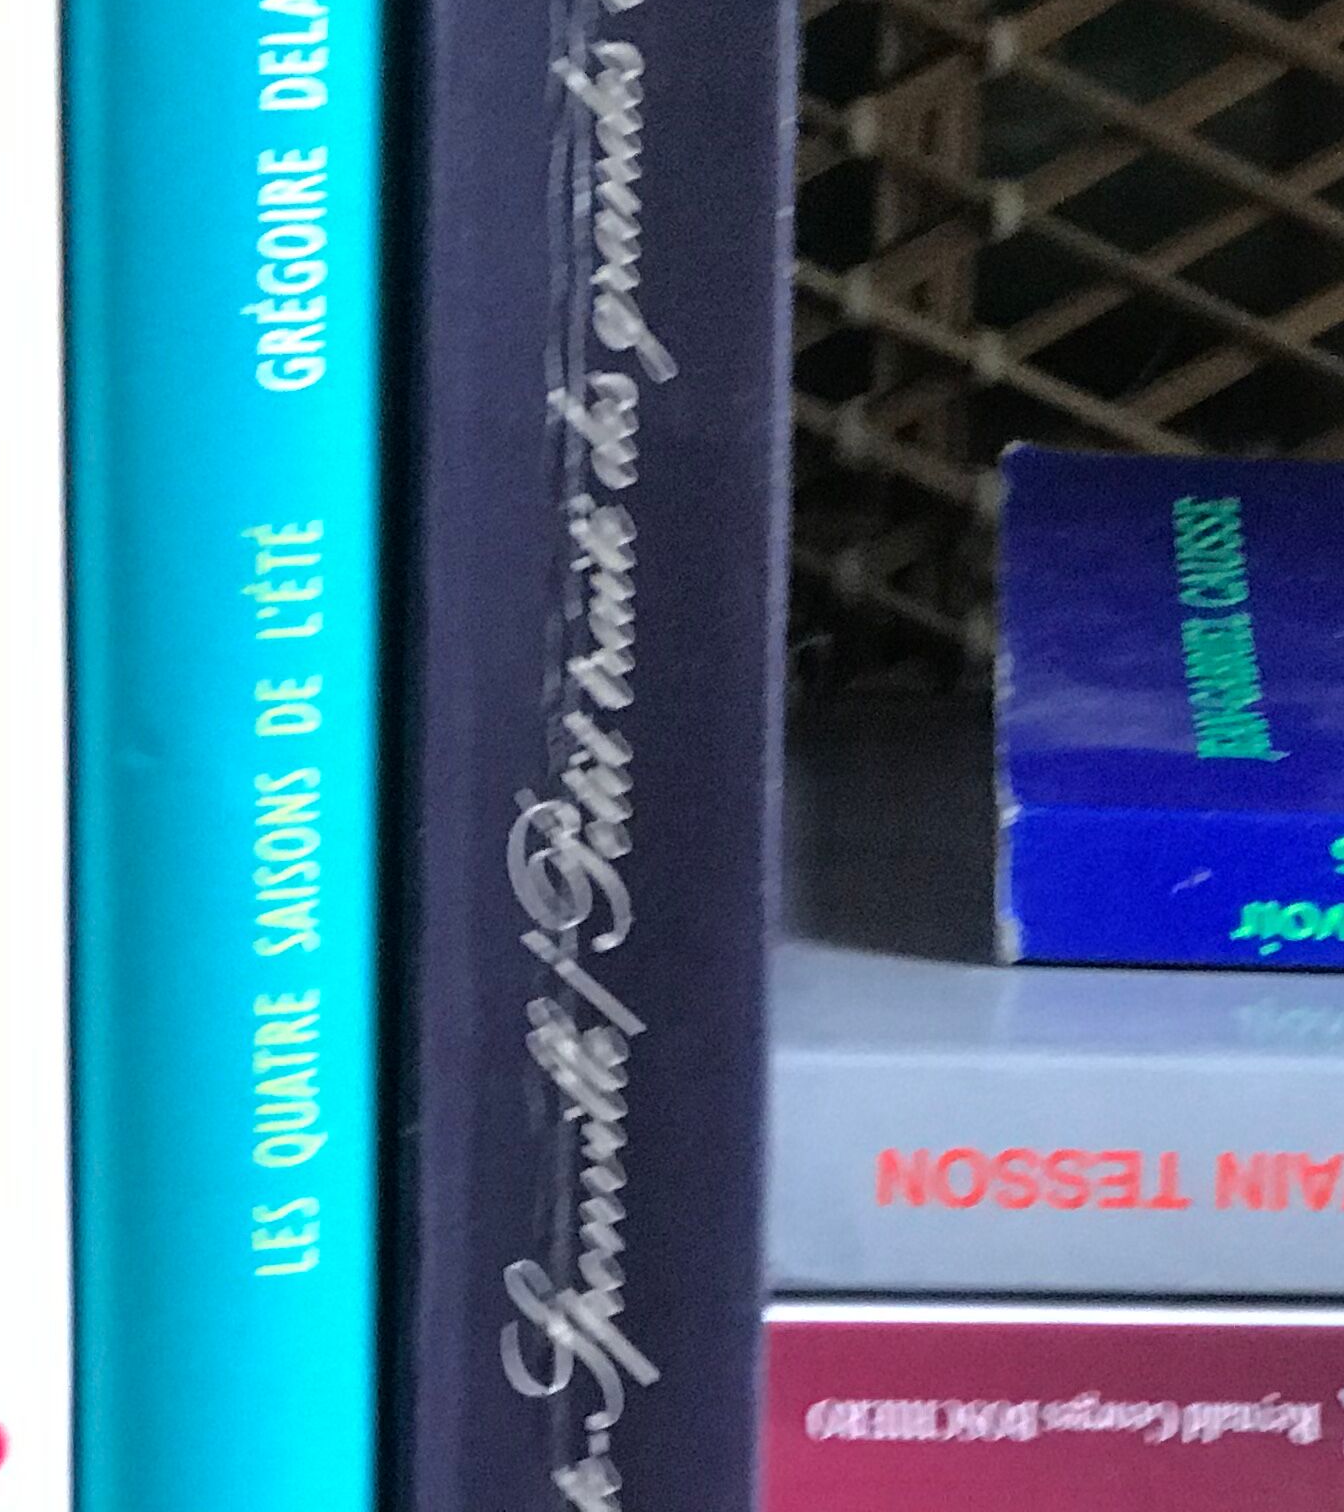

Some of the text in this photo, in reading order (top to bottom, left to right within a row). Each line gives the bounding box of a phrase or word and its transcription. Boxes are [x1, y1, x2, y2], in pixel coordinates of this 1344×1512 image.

[243, 146, 331, 391] GRÉGOIRE
[548, 42, 679, 384] grandes
[546, 370, 641, 489] des
[239, 520, 328, 1278] LES QUATRE SAISONS DE L'ÉTÉ
[506, 712, 634, 952] Petit
[876, 1147, 1193, 1210] TESSON
